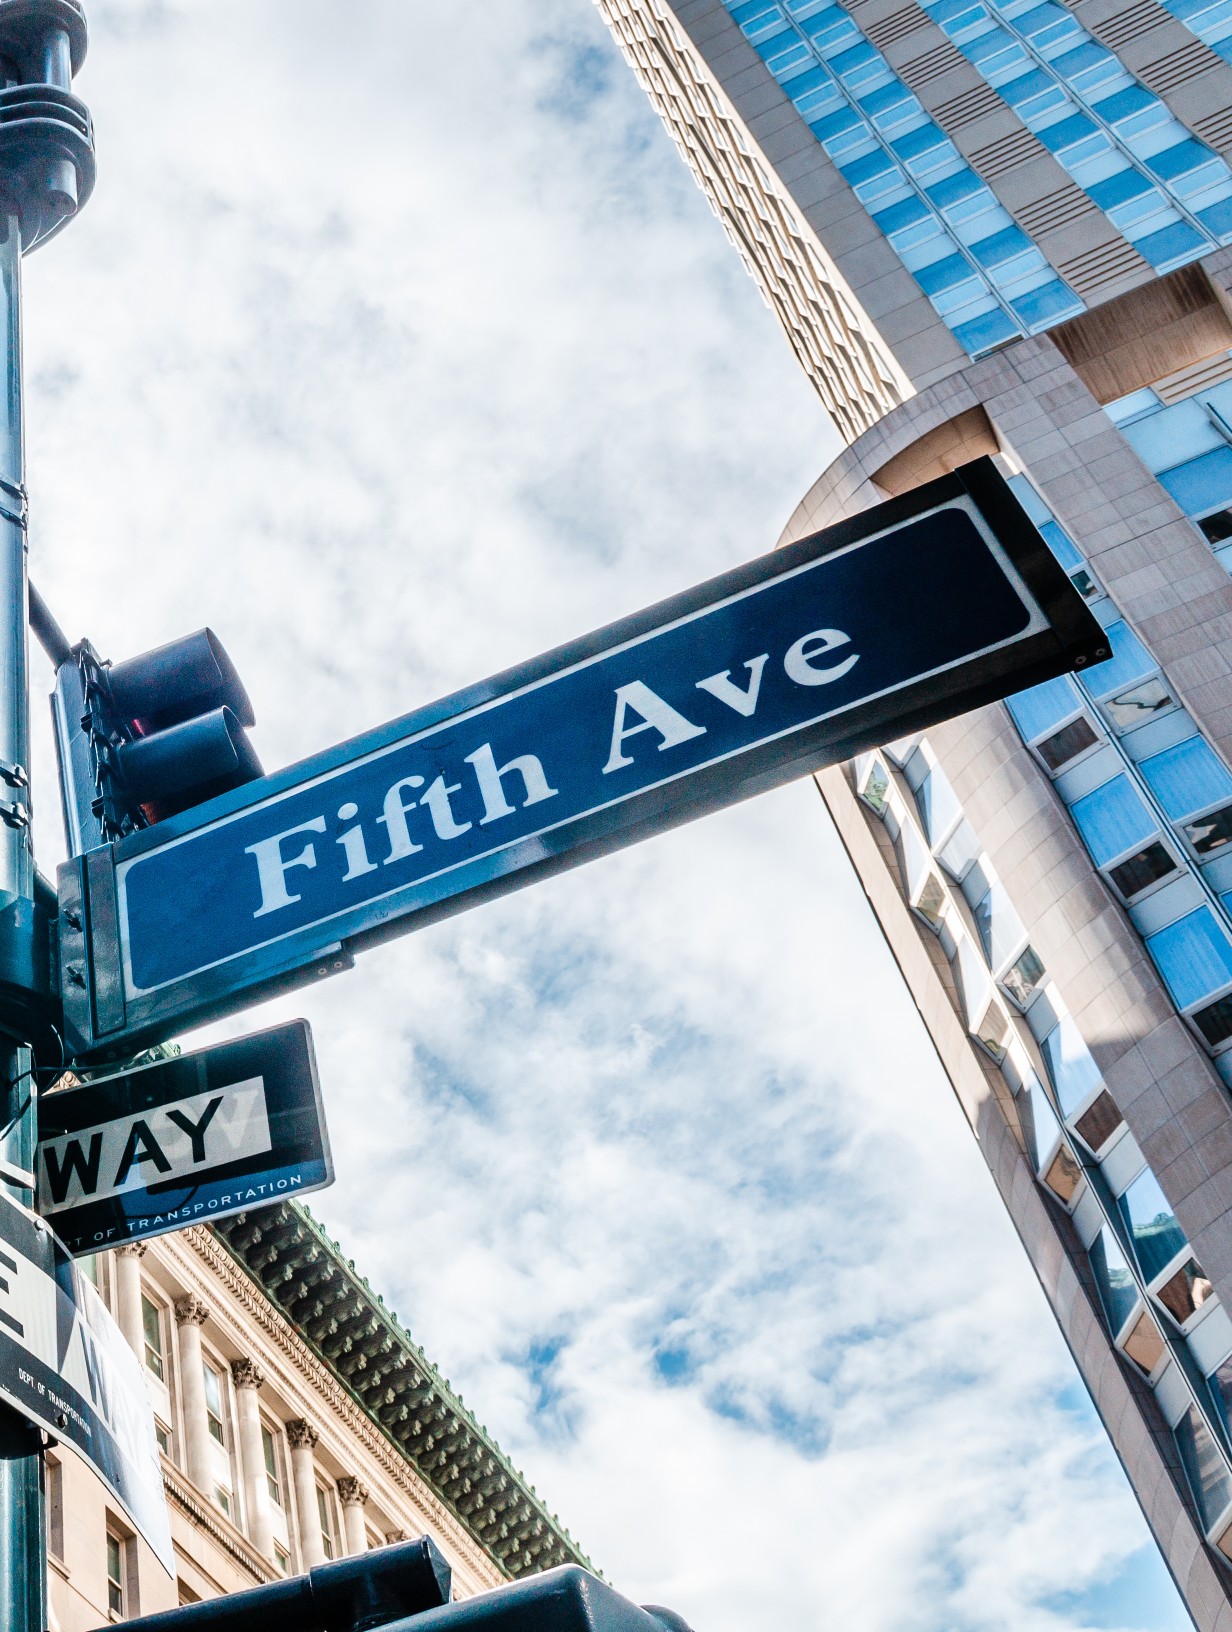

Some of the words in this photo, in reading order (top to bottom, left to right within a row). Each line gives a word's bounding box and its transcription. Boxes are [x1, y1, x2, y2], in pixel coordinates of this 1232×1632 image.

[244, 742, 559, 919] Fifth
[602, 628, 861, 775] Ave
[43, 1095, 224, 1205] WAY
[93, 1227, 116, 1241] OF
[127, 1174, 303, 1231] TRANSPORTATION
[37, 1382, 46, 1396] OF
[48, 1389, 92, 1437] TRANSPORTATION
